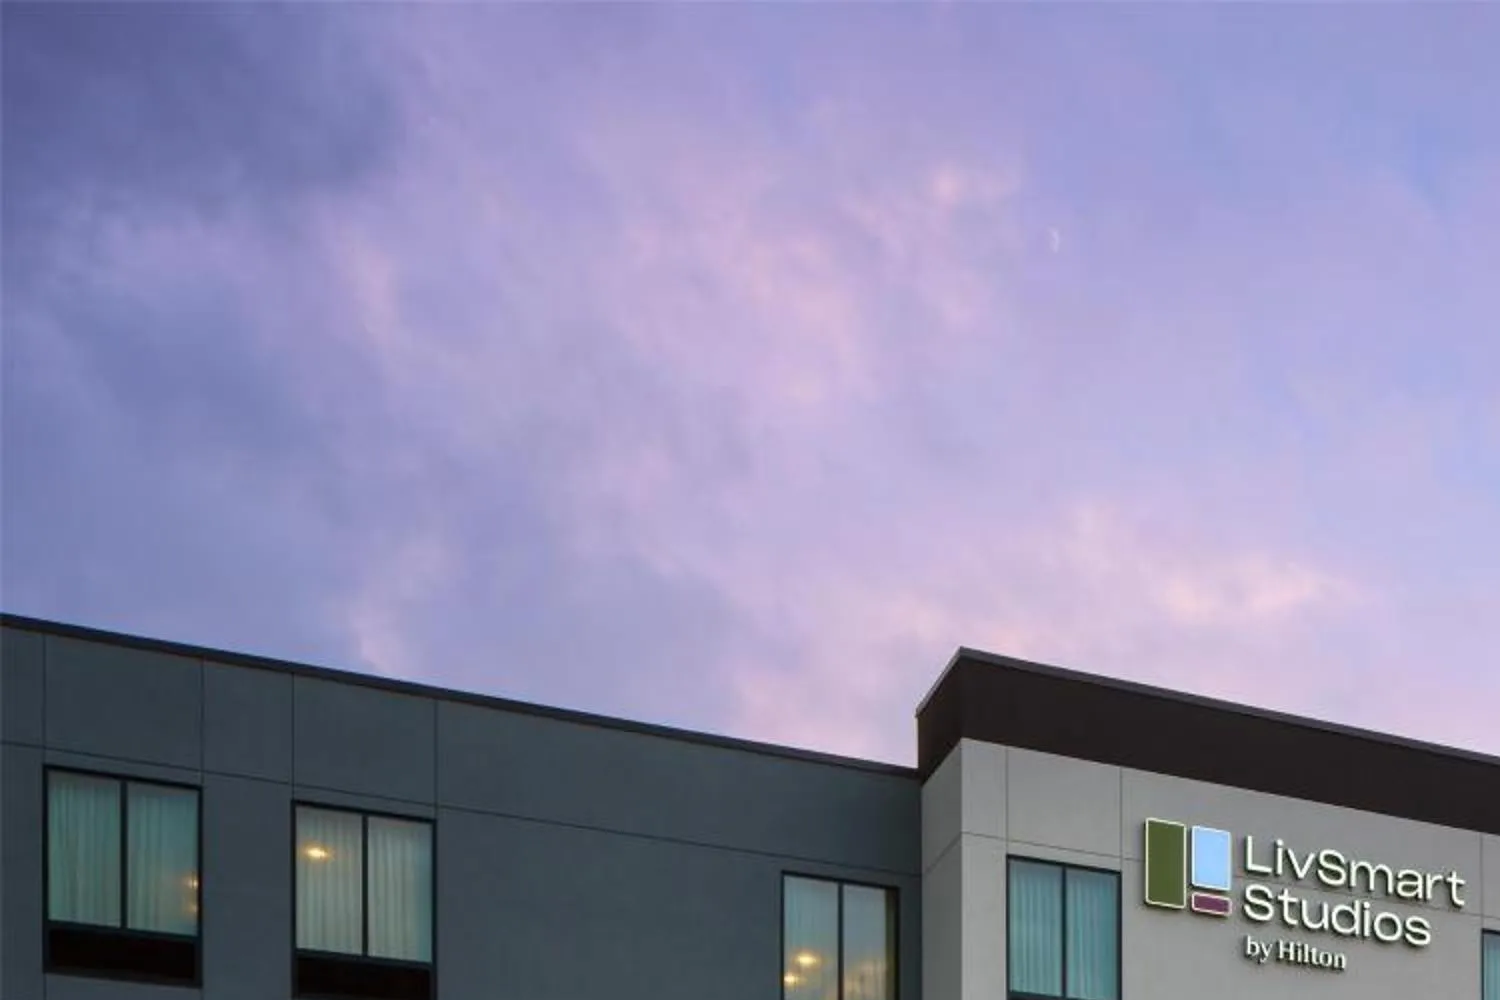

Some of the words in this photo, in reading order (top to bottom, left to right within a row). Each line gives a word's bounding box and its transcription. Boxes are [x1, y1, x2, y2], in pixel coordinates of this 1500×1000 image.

[1245, 835, 1466, 907] LivSmart
[1243, 884, 1432, 946] Studios
[1246, 935, 1273, 963] by
[1279, 940, 1347, 969] Hilton
